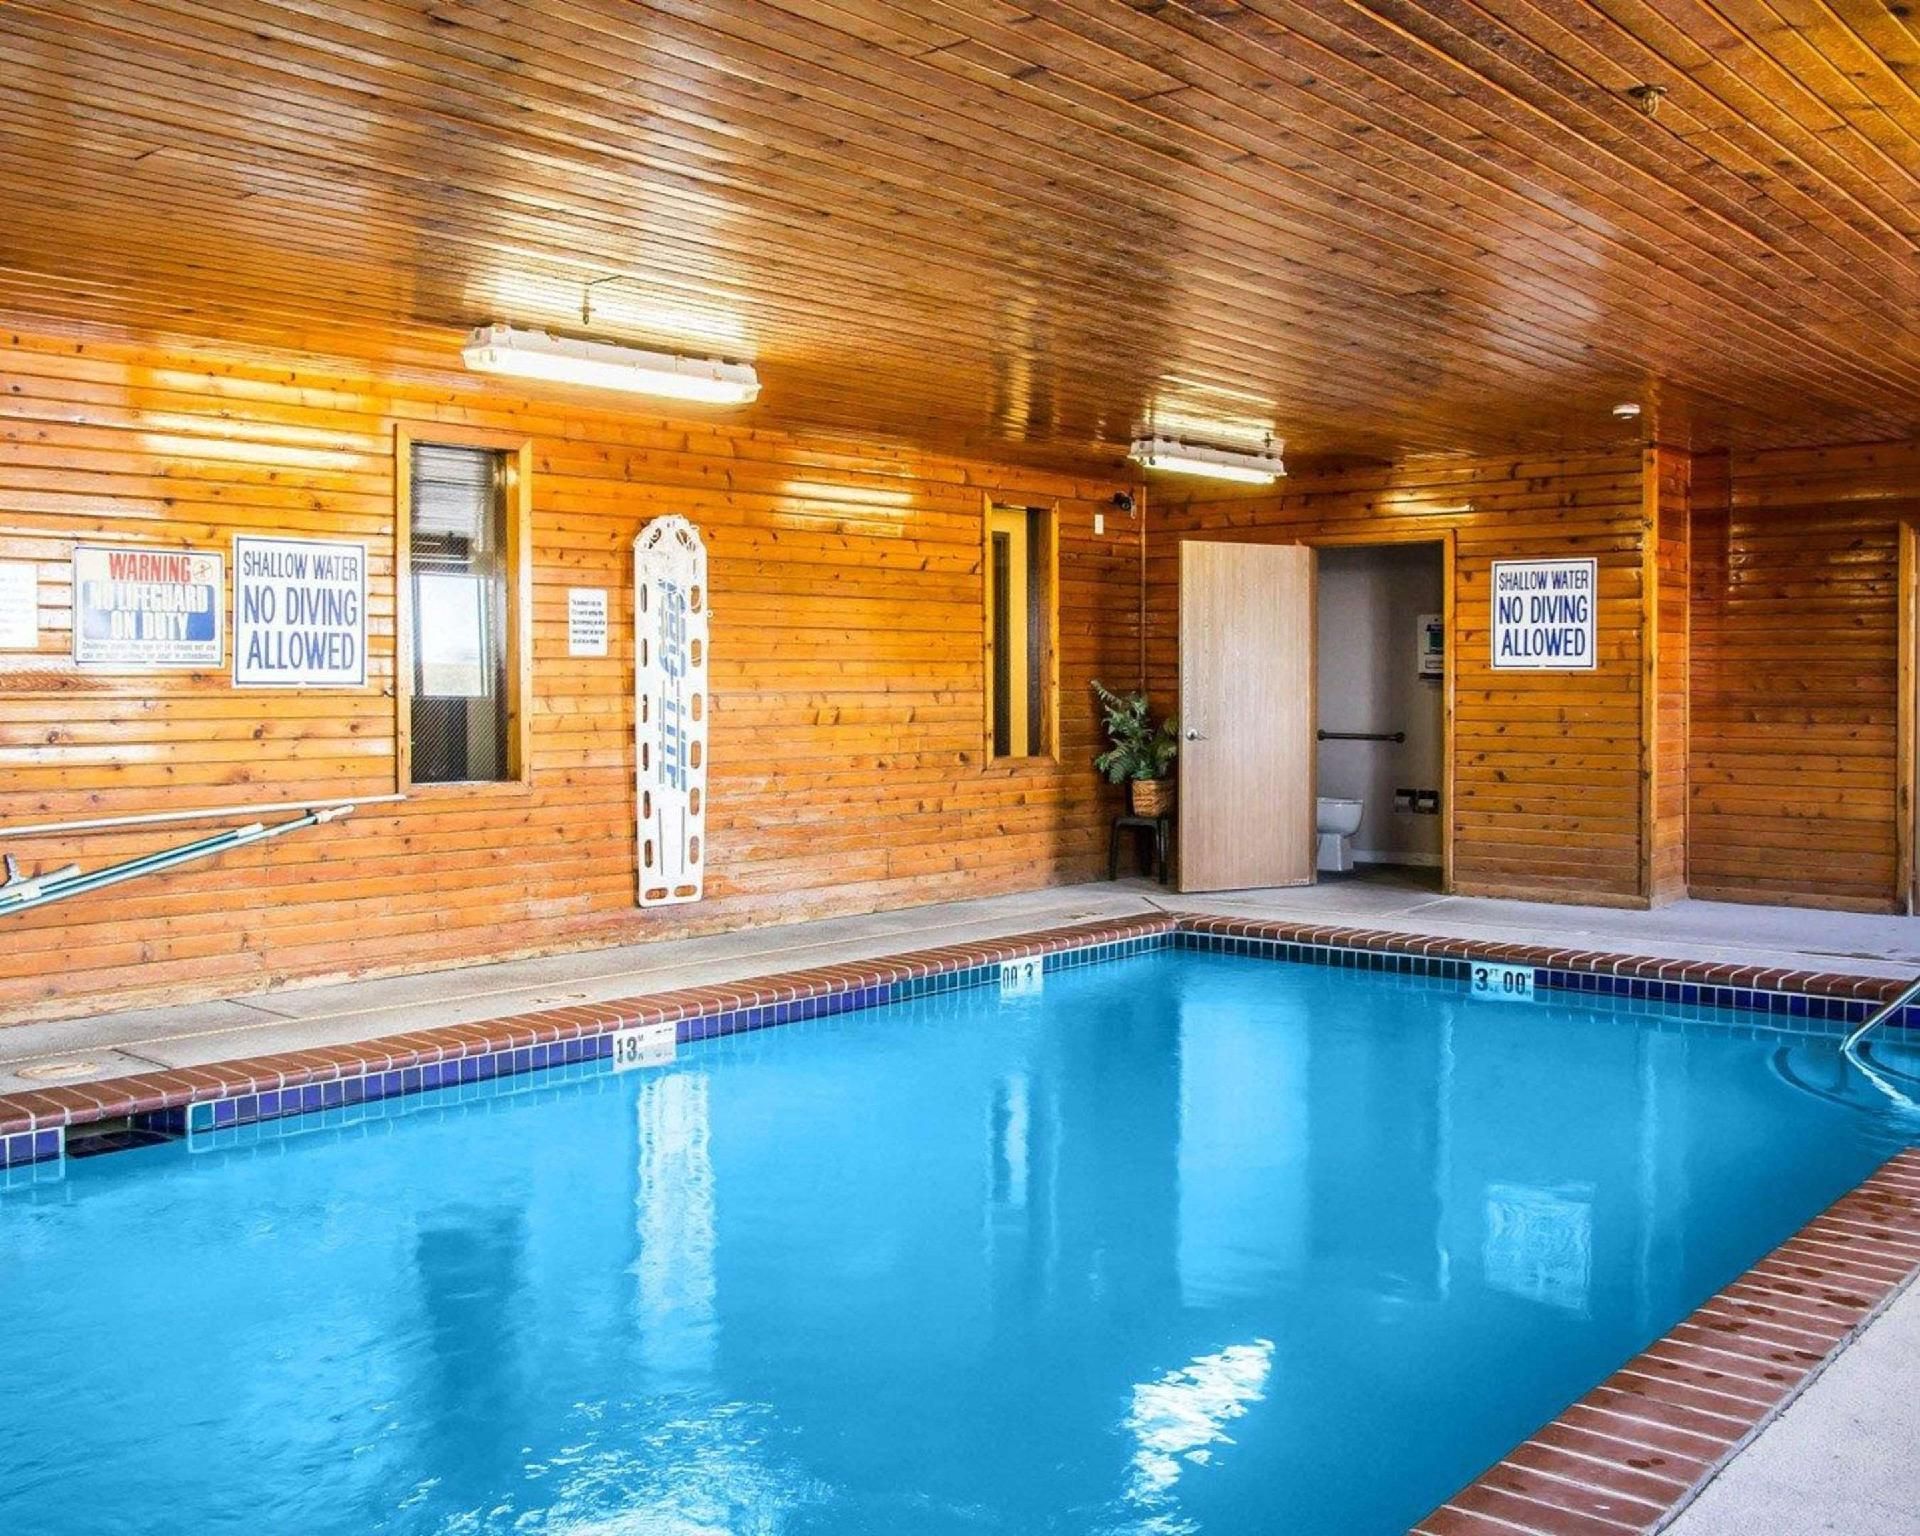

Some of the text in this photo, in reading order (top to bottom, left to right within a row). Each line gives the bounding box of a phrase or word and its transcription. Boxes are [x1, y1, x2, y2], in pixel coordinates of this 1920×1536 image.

[108, 553, 192, 583] WARNING
[243, 550, 358, 581] SHALLOW WATER
[1499, 569, 1588, 591] SHALLOW WATER
[244, 584, 357, 626] NO DIVING
[1499, 595, 1588, 625] NO DIVING
[110, 610, 188, 641] ON DUTY
[246, 630, 355, 670] ALLOWED
[1501, 628, 1586, 657] ALLOWED
